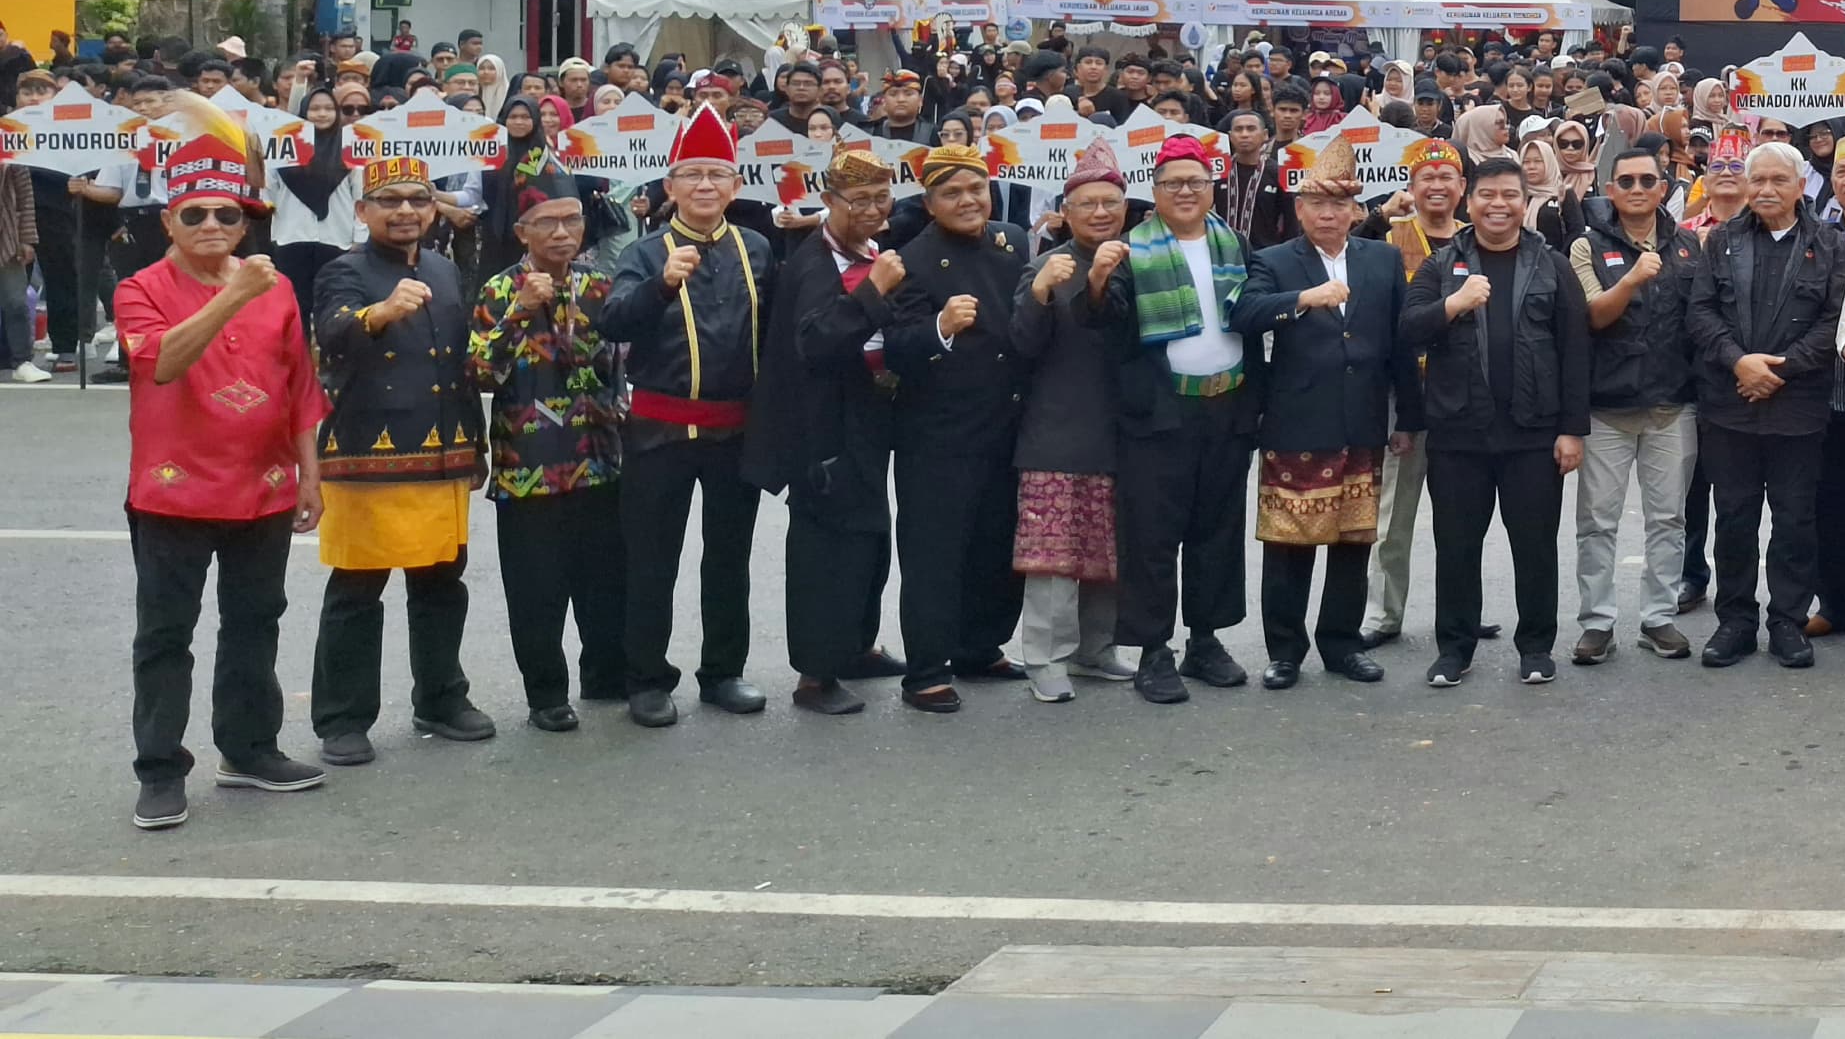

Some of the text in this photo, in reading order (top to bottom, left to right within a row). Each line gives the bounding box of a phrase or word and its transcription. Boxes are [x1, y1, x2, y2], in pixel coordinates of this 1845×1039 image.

[1790, 78, 1807, 91] KK
[4, 132, 28, 150] KK
[629, 138, 647, 151] KK
[354, 141, 498, 157] KK BETAWI/KWB
[1048, 148, 1067, 162] KK
[566, 154, 627, 169] MADURA
[998, 164, 1068, 180] SASAK/LO
